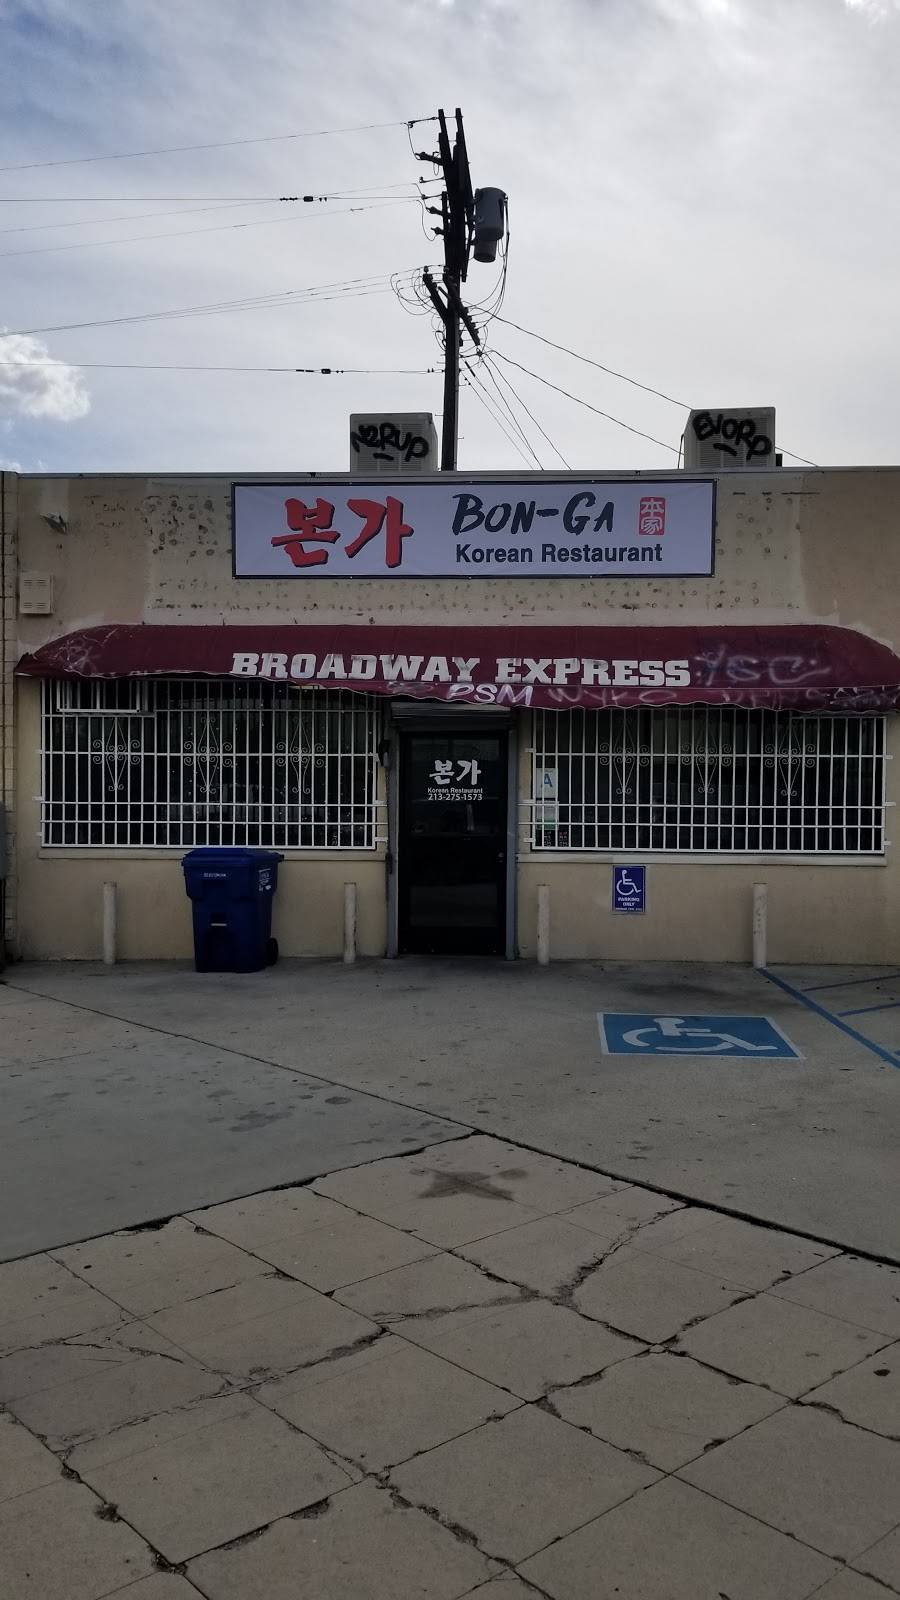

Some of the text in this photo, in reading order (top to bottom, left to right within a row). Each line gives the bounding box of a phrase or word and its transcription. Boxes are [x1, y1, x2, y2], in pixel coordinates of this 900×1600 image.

[271, 495, 414, 568] 본가
[456, 543, 663, 563] Korean Restaurant
[230, 652, 692, 687] BROADWAY EXPRESS
[429, 759, 482, 785] 본가
[541, 773, 553, 788] A
[428, 793, 483, 801] 213-275-1573
